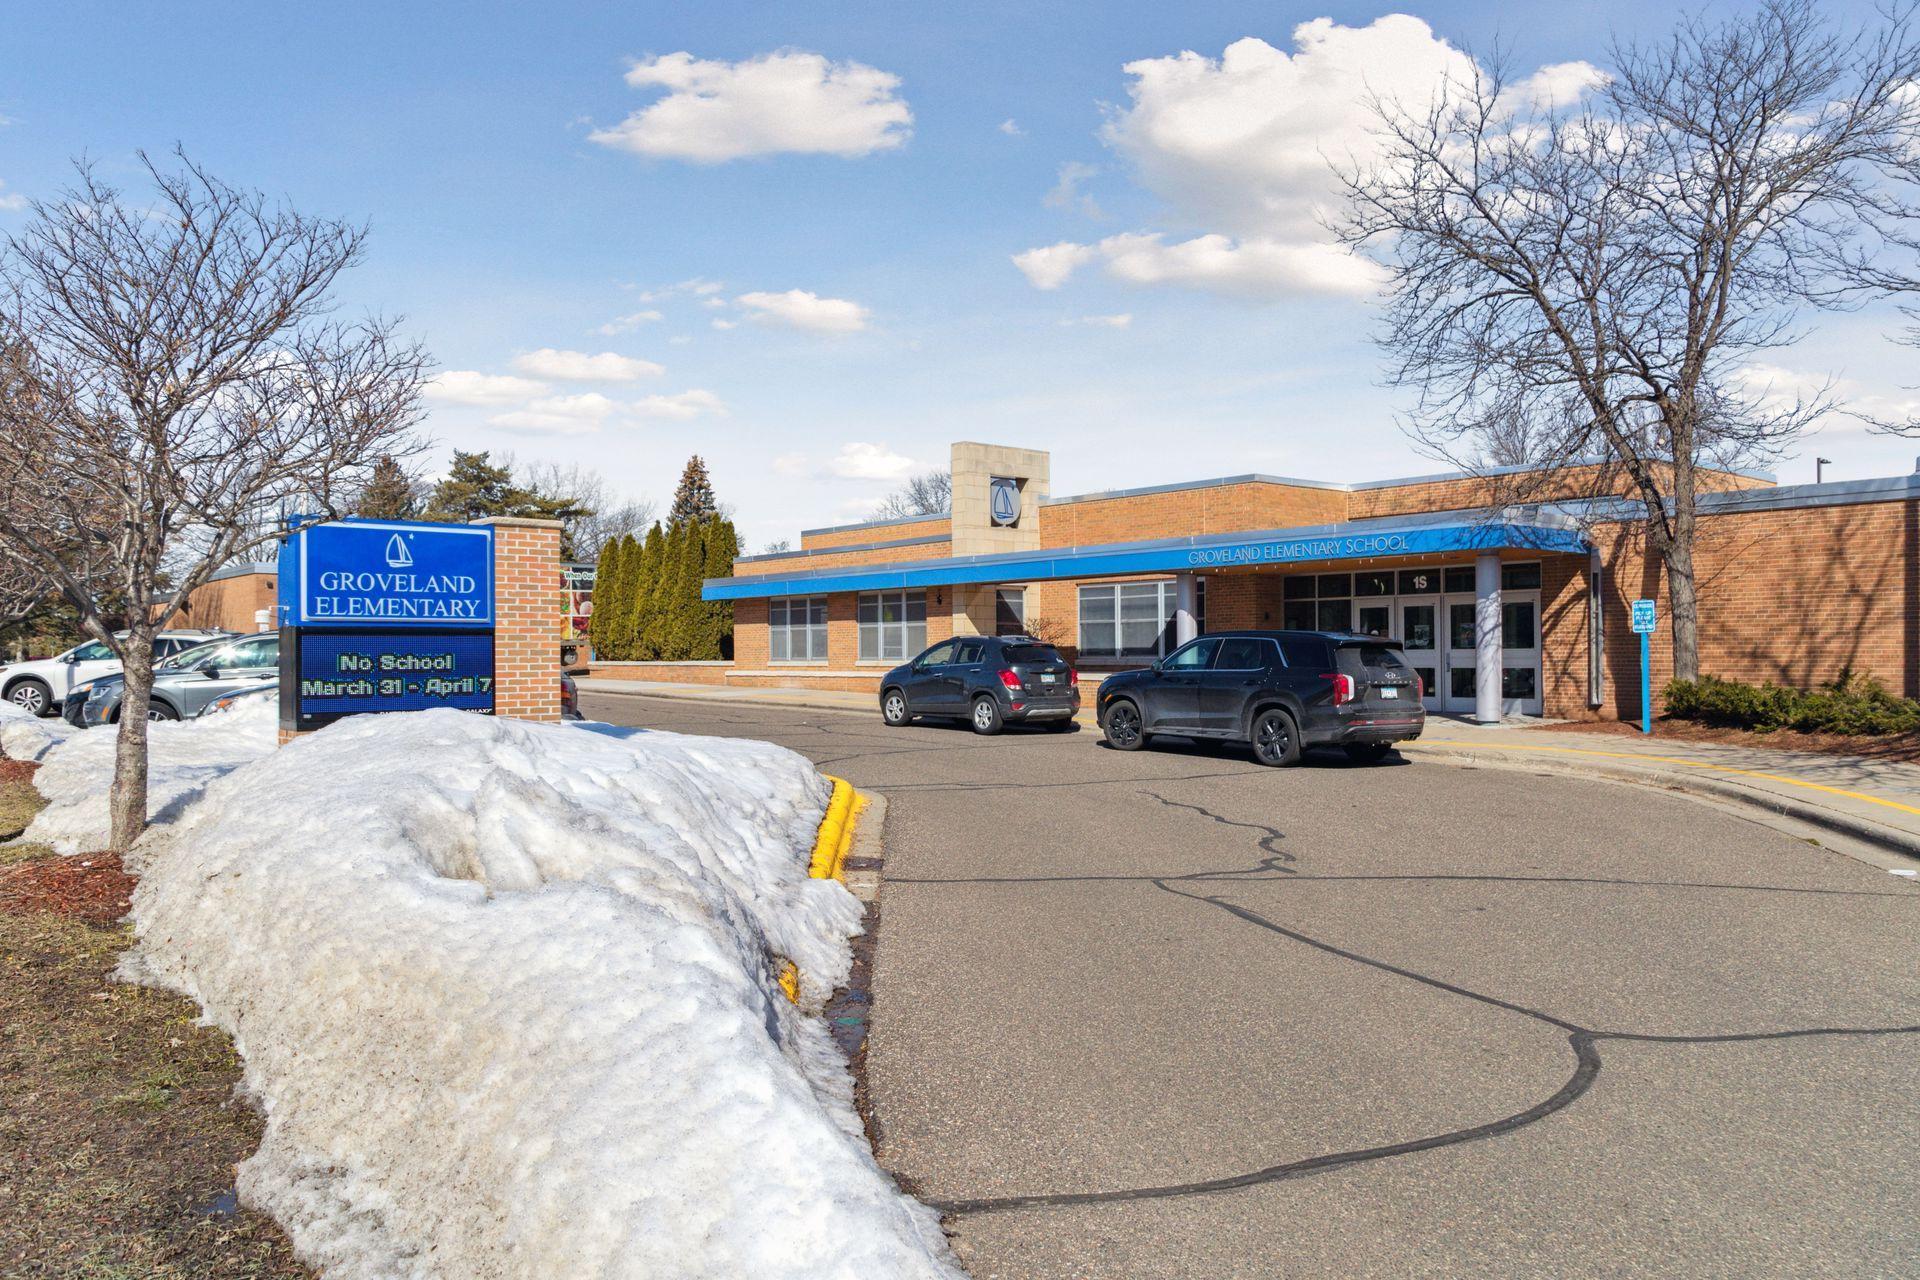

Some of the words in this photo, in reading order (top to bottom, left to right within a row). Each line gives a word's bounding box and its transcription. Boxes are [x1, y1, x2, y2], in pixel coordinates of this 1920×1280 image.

[1188, 547, 1261, 565] GROVELAND
[1264, 540, 1343, 560] ELEMENTARY
[1346, 536, 1409, 554] SCHOOL
[320, 572, 476, 594] GROVELAND
[315, 597, 481, 618] ELEMENTARY
[340, 655, 372, 671] No
[380, 655, 452, 671] School
[302, 679, 374, 696] March
[380, 679, 402, 695] 31
[426, 678, 474, 697] April
[479, 678, 492, 693] 7
